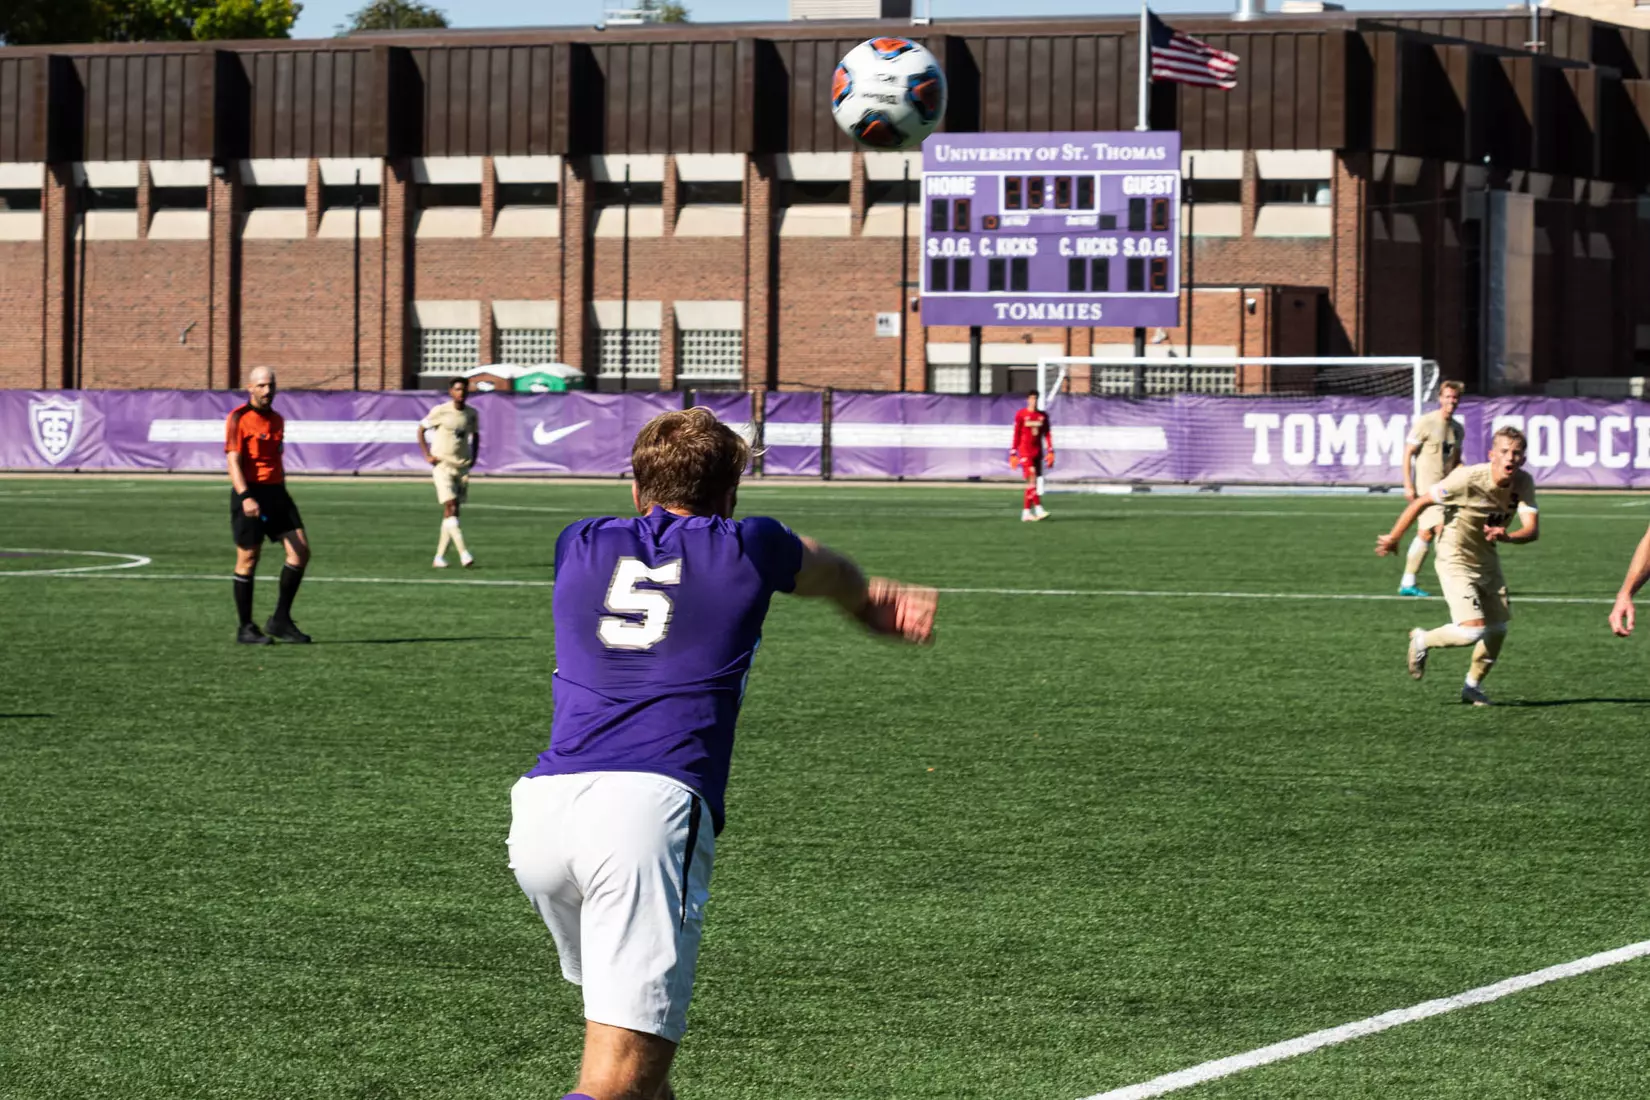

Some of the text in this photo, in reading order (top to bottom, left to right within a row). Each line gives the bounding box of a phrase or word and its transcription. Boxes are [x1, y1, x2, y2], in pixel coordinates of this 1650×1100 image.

[1062, 144, 1089, 161] ST.
[1092, 143, 1166, 161] THOMAS
[927, 176, 976, 196] HOME
[1122, 175, 1175, 195] GUEST
[927, 237, 1038, 257] S.O.G. C. KICKS
[1059, 237, 1173, 256] C. KICKS S.O.G.
[1150, 258, 1167, 290] 2
[993, 303, 1103, 320] TOMMIES
[1243, 413, 1465, 467] TOMM
[596, 556, 682, 650] 5
